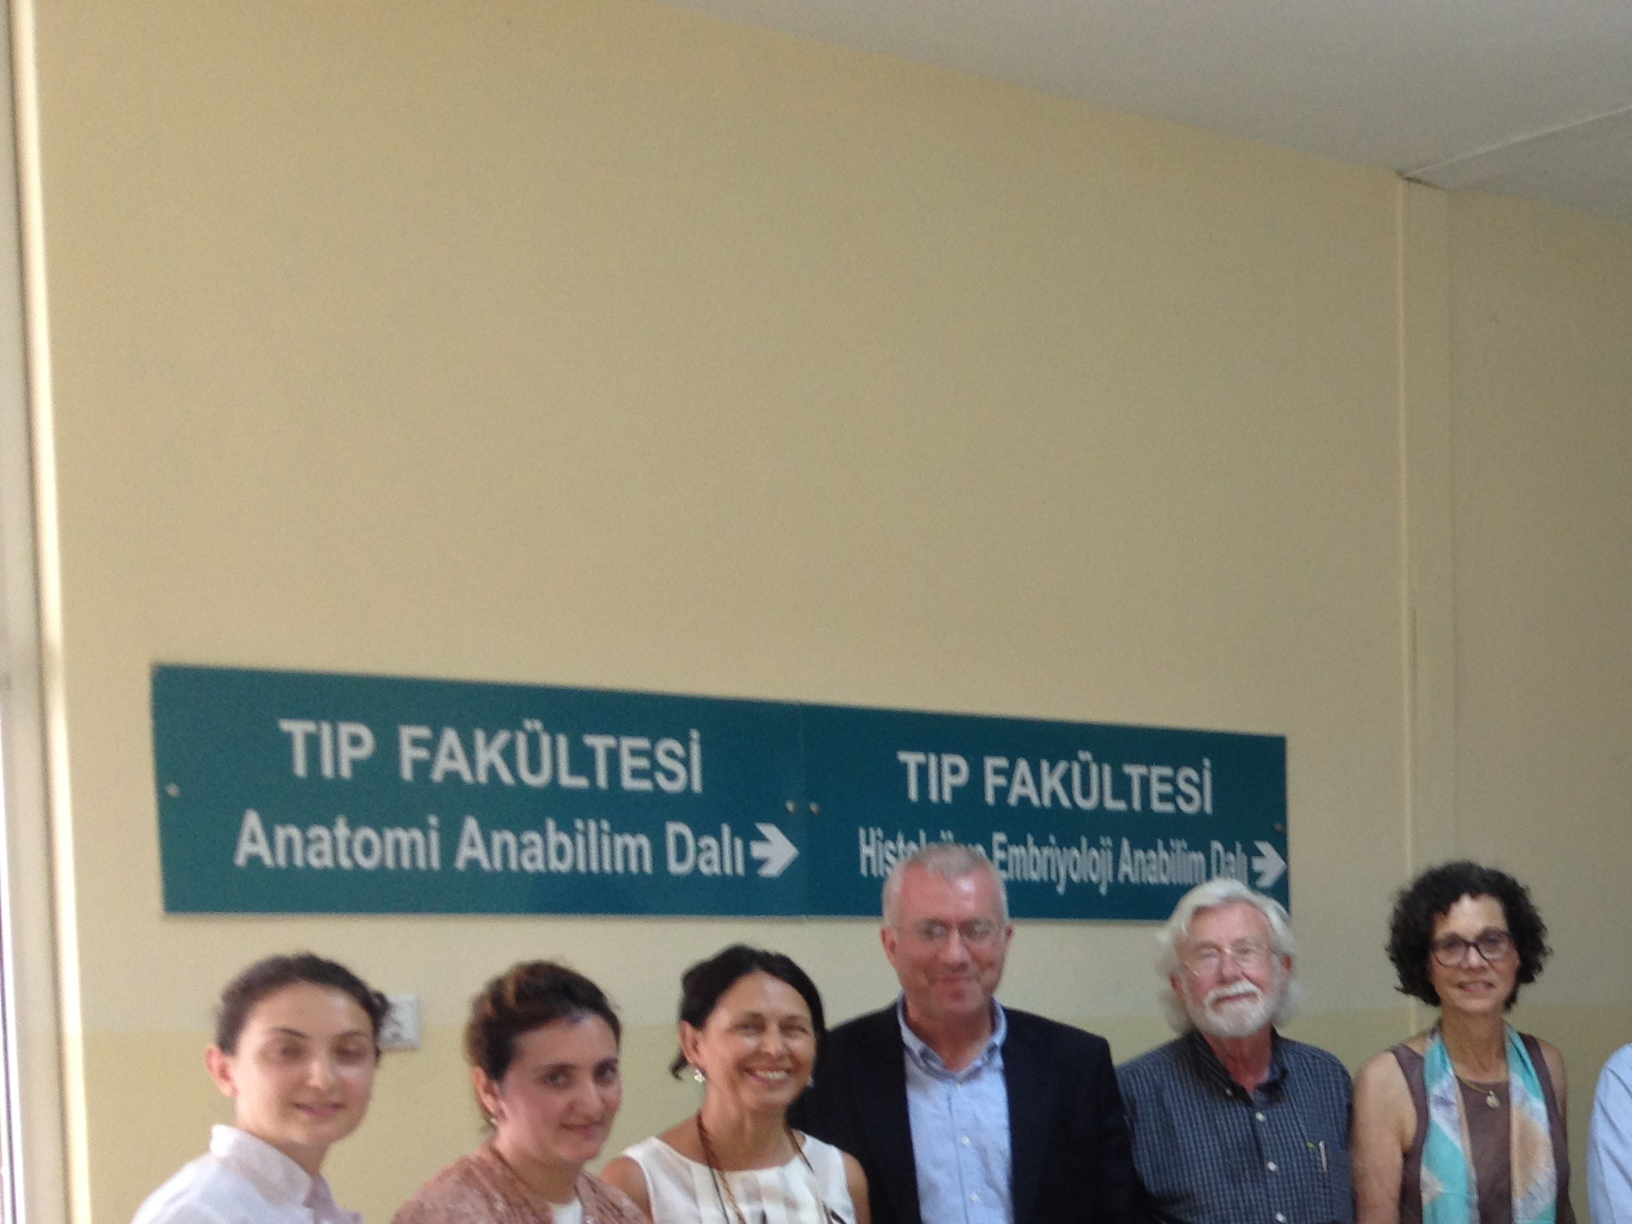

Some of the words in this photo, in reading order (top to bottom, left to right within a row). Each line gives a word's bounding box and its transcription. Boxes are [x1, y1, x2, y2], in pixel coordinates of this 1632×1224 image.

[278, 718, 377, 781] TIP
[398, 717, 704, 795] FAKÜLTESİ
[896, 751, 970, 803] TIP
[983, 749, 1213, 815] FAKÜLTESİ
[233, 808, 441, 871] Anatomi
[453, 815, 654, 875] Anabilim
[664, 820, 746, 877] Dalı
[991, 830, 1114, 896] Embriyoloji
[1117, 835, 1207, 886] Anabilim
